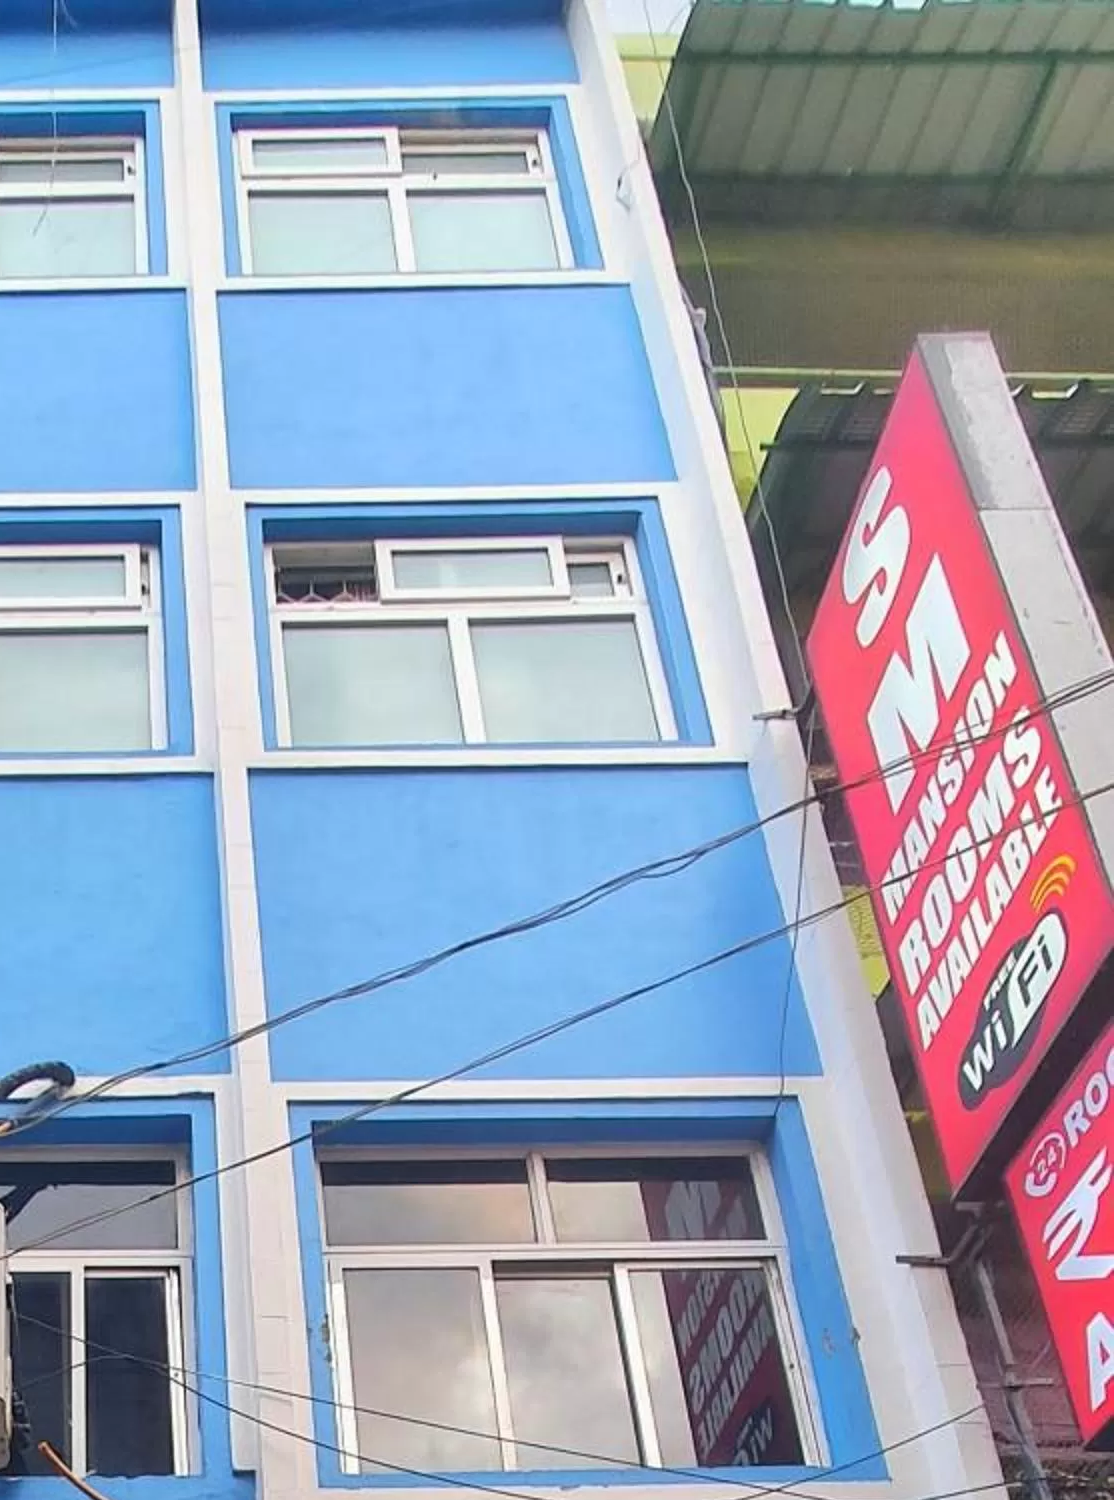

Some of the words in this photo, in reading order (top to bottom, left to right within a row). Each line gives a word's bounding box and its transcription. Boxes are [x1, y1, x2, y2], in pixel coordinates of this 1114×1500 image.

[841, 464, 910, 649] S
[867, 552, 971, 816] M
[881, 630, 1018, 924] MANSION
[899, 705, 1041, 996] ROOMS
[917, 764, 1063, 1051] AVAILABLE
